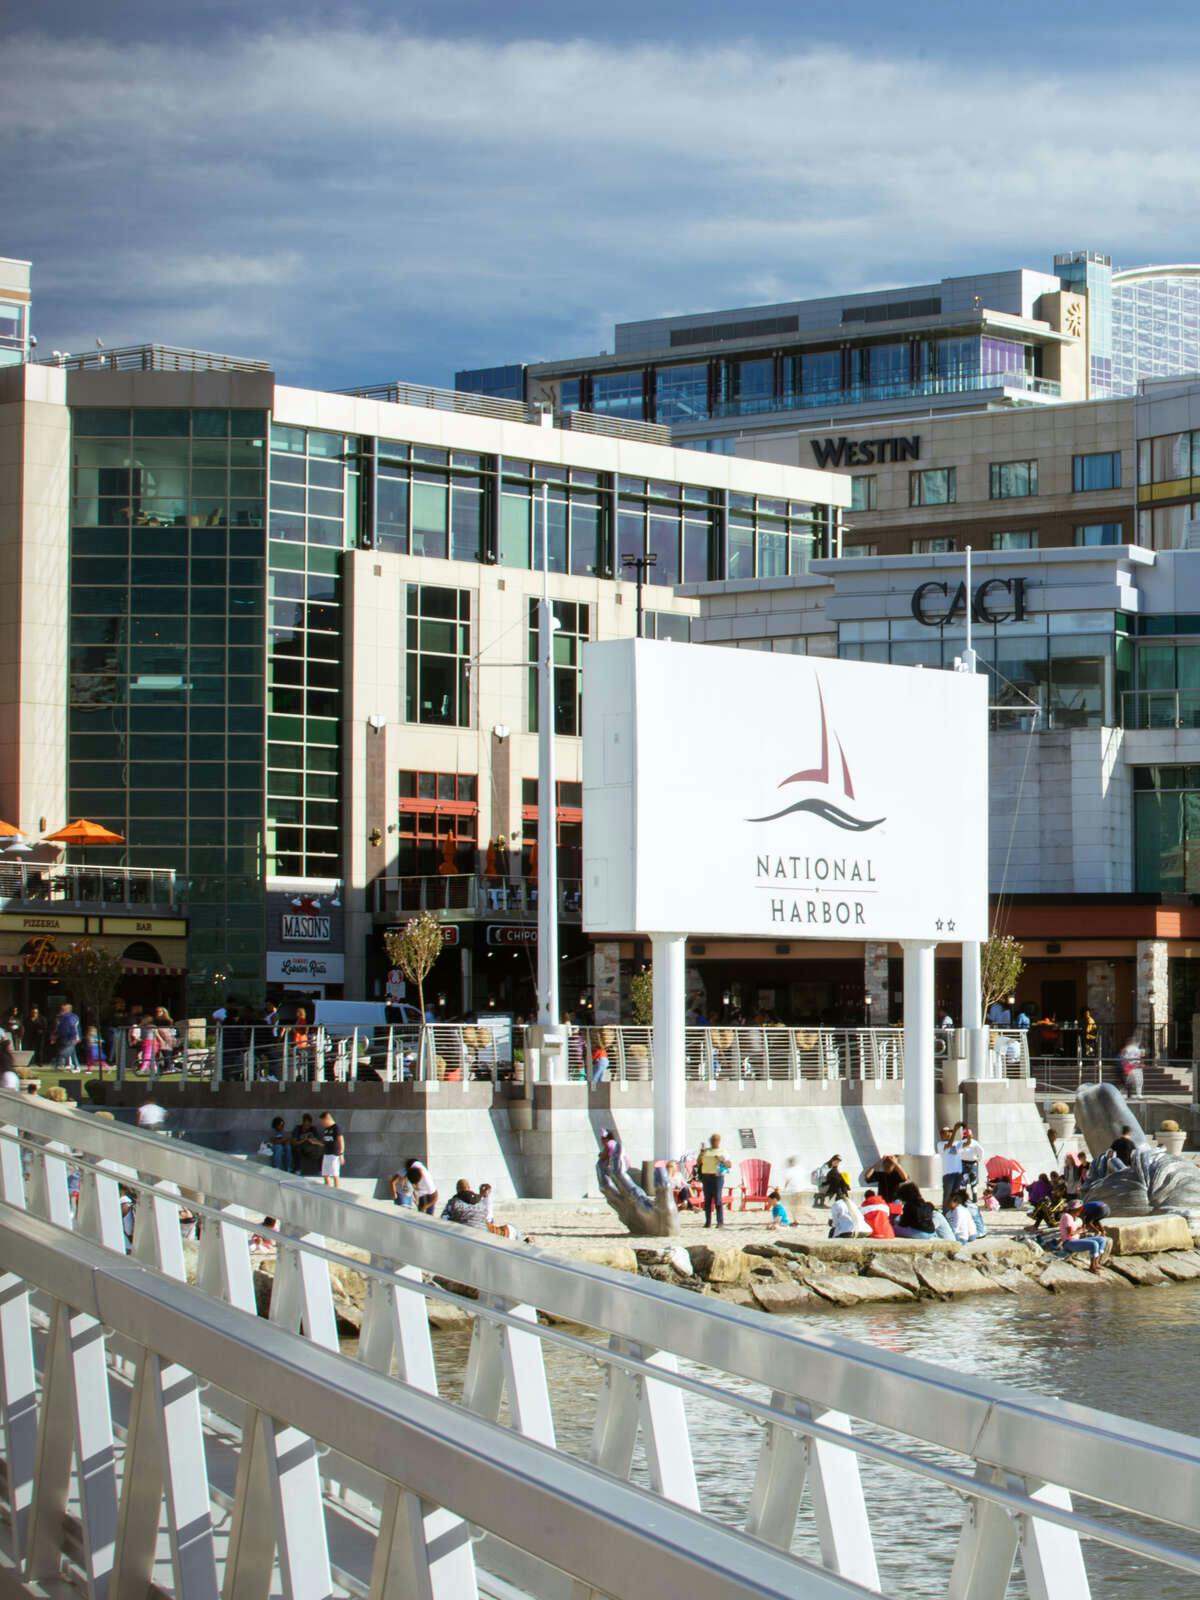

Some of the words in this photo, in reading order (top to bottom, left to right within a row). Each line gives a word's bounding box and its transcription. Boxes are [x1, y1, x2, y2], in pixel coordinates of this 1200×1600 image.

[810, 436, 920, 469] WESTIN
[911, 577, 1028, 626] CACI
[756, 855, 876, 882] NATIONAL
[23, 918, 60, 929] PIZZERIA
[771, 899, 866, 924] HARBOR
[136, 922, 152, 931] BAR
[506, 930, 538, 941] CHIPO
